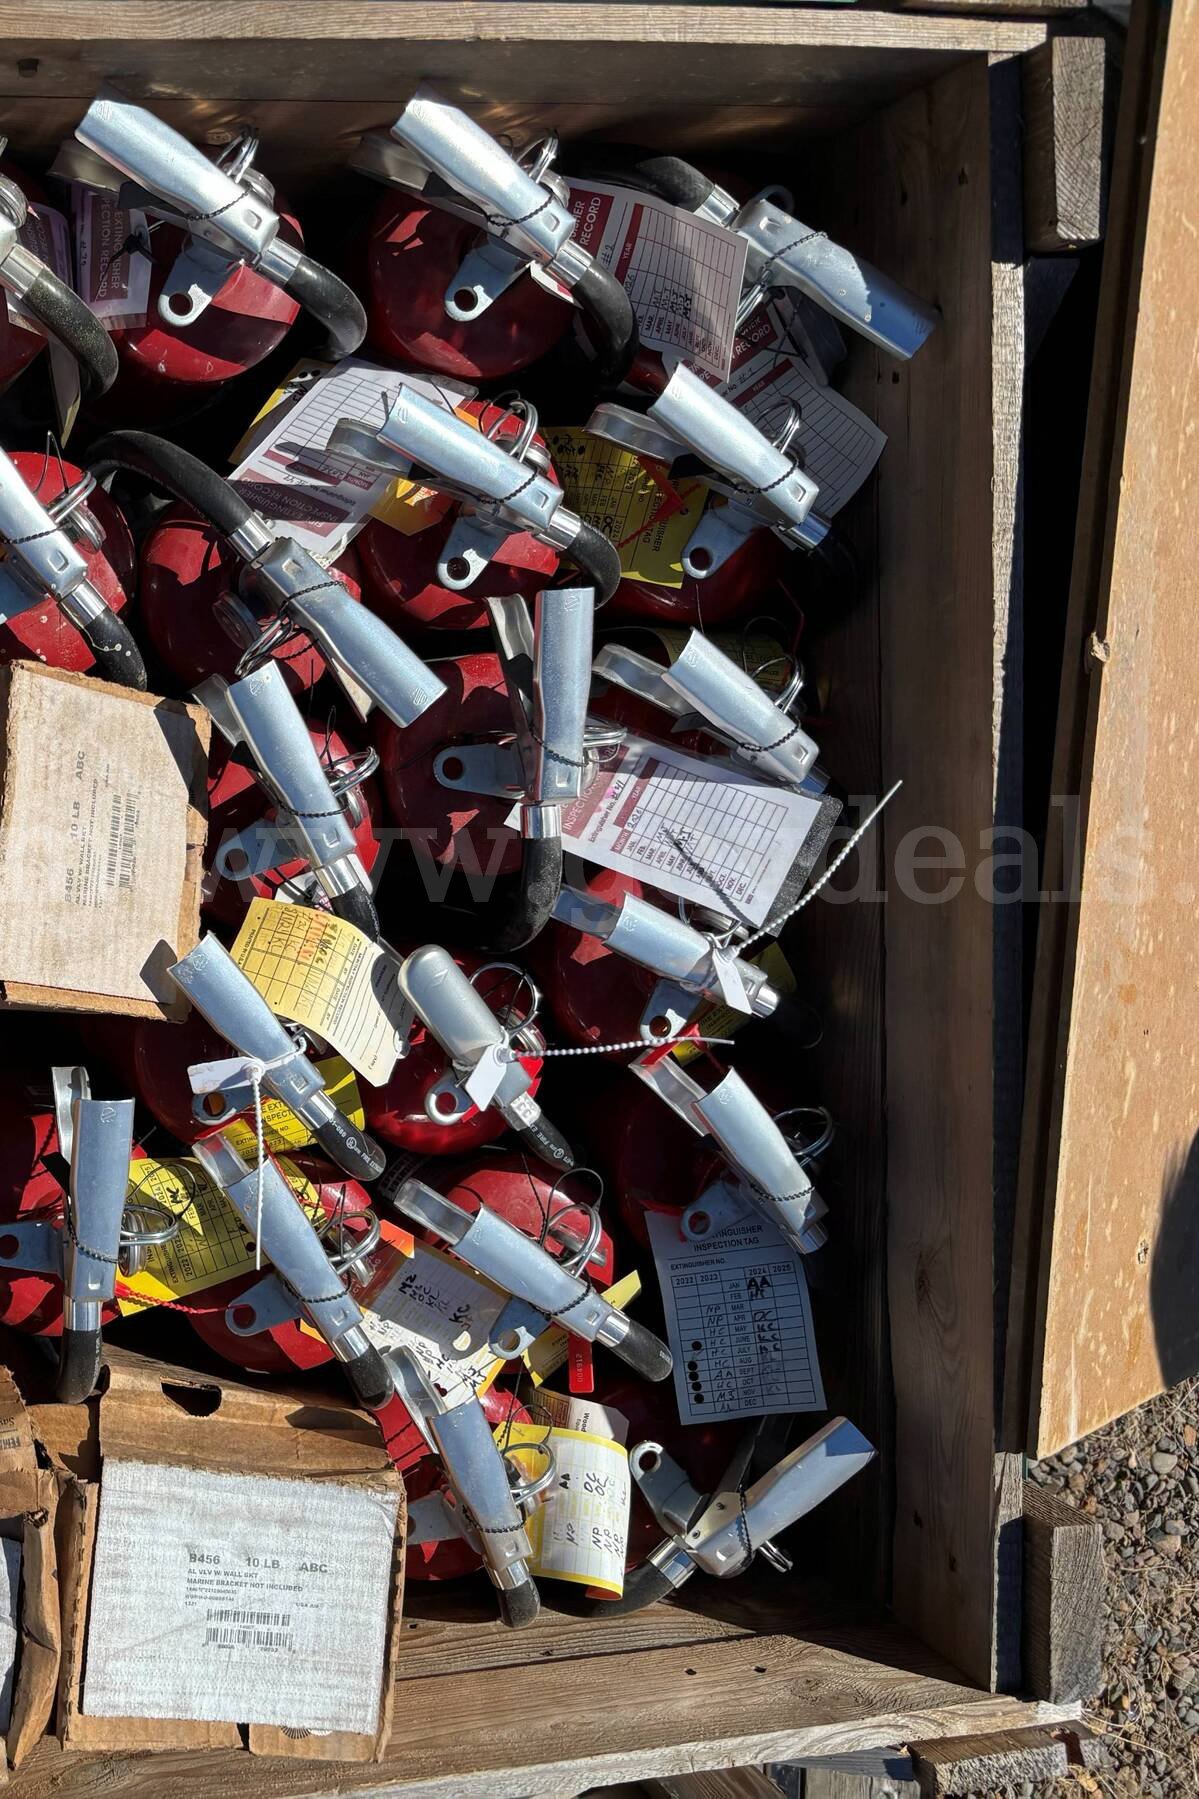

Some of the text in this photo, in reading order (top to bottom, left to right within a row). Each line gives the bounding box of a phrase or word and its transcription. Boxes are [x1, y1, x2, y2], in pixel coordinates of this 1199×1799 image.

[580, 197, 601, 245] RECORD
[622, 242, 632, 260] YEAR
[237, 484, 302, 522] EXTINGUISHER
[240, 475, 338, 525] INSPECTION RECORD
[65, 751, 84, 903] B456 10 LB ABC
[348, 943, 359, 956] DATE
[331, 987, 341, 1001] DATE
[536, 1132, 550, 1145] FIRE
[693, 1236, 759, 1253] INSPECTION TAG
[181, 1258, 192, 1277] 2022
[575, 1354, 583, 1383] 004912
[592, 1527, 603, 1550] NP
[189, 1553, 328, 1573] B456 10 LB ABC
